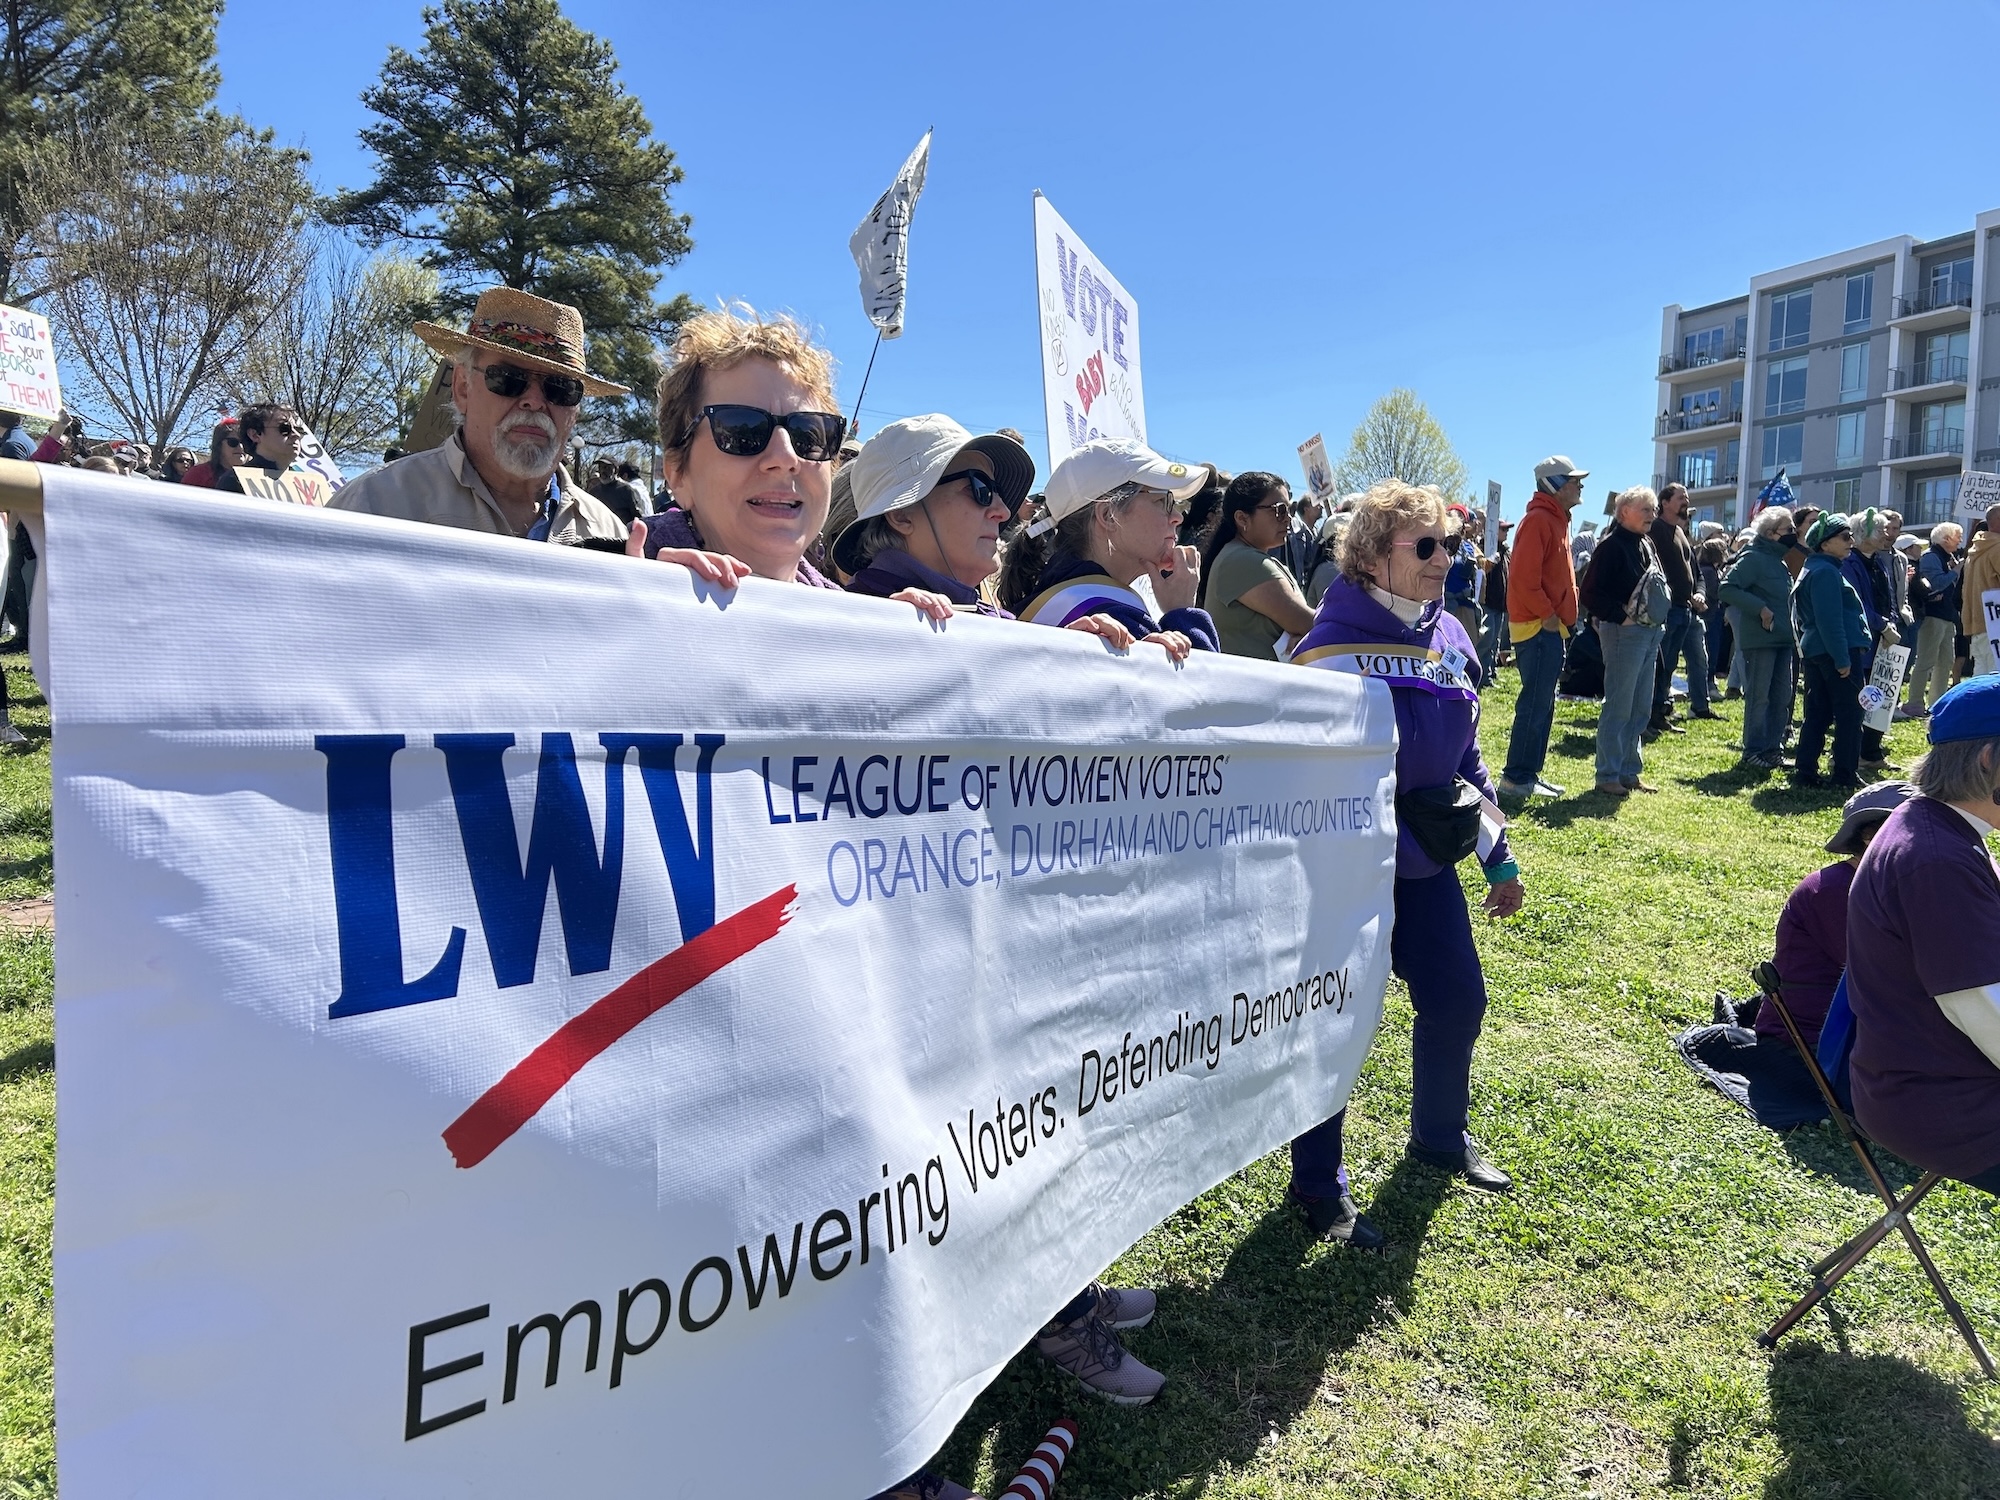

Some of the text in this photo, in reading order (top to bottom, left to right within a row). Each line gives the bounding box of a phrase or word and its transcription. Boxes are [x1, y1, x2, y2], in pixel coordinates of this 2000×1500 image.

[1056, 232, 1128, 372] VOTE
[10, 319, 36, 341] said
[18, 345, 44, 361] your
[7, 383, 56, 414] THEM!
[1076, 350, 1107, 416] BABY
[1119, 372, 1132, 403] NO
[1964, 488, 1975, 498] of
[1967, 475, 1977, 487] in
[1978, 475, 1994, 489] the
[1355, 654, 1435, 680] VOTES
[762, 754, 950, 825] LEAGUE
[961, 764, 1000, 811] OF
[1009, 753, 1134, 808] WOMEN
[827, 796, 1372, 907] ORANGE, DURHAM AND CHATHAM COUNTIES
[314, 732, 726, 1020] LWV
[404, 967, 1353, 1442] Empowering Voters. Defending Democracy.
